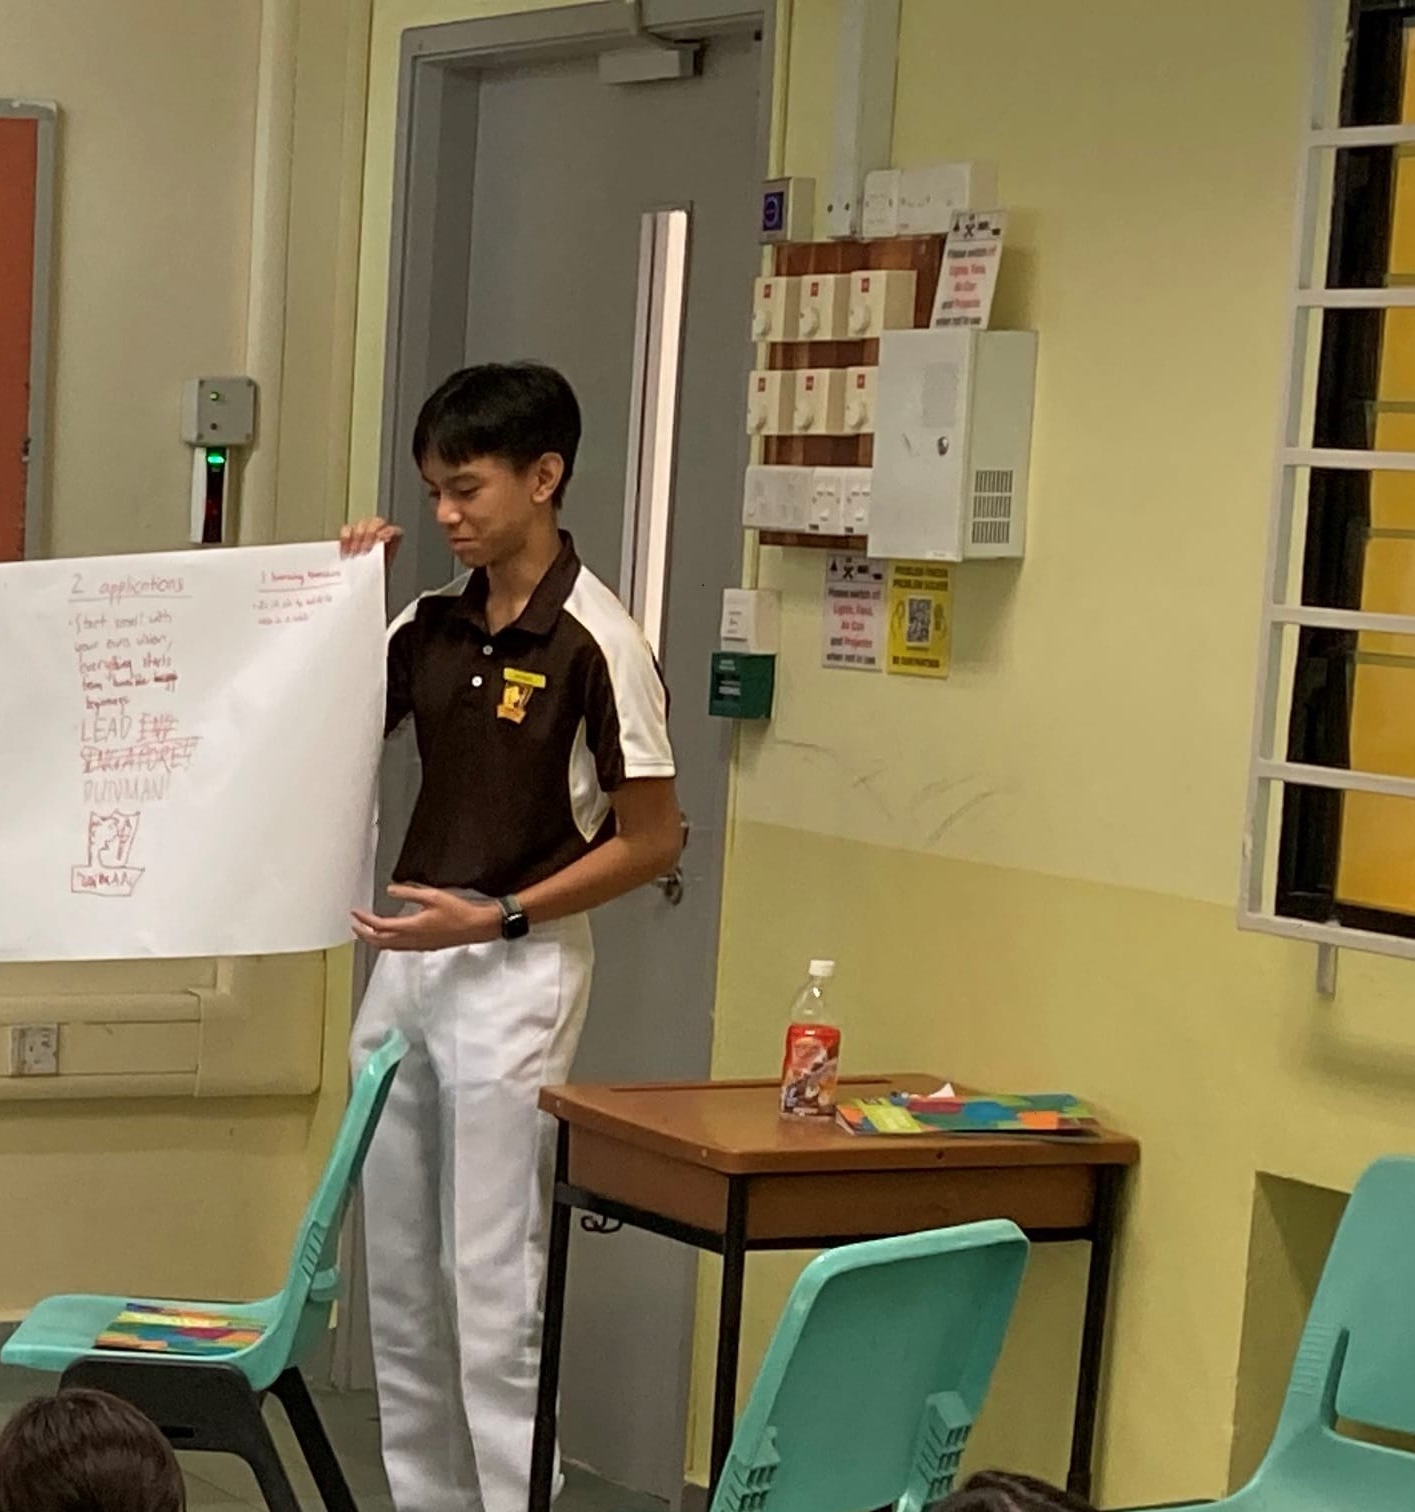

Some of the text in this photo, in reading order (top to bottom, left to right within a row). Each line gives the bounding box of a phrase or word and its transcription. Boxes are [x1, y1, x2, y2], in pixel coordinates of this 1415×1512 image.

[71, 572, 186, 607] 2 applications
[80, 714, 134, 744] LEAD
